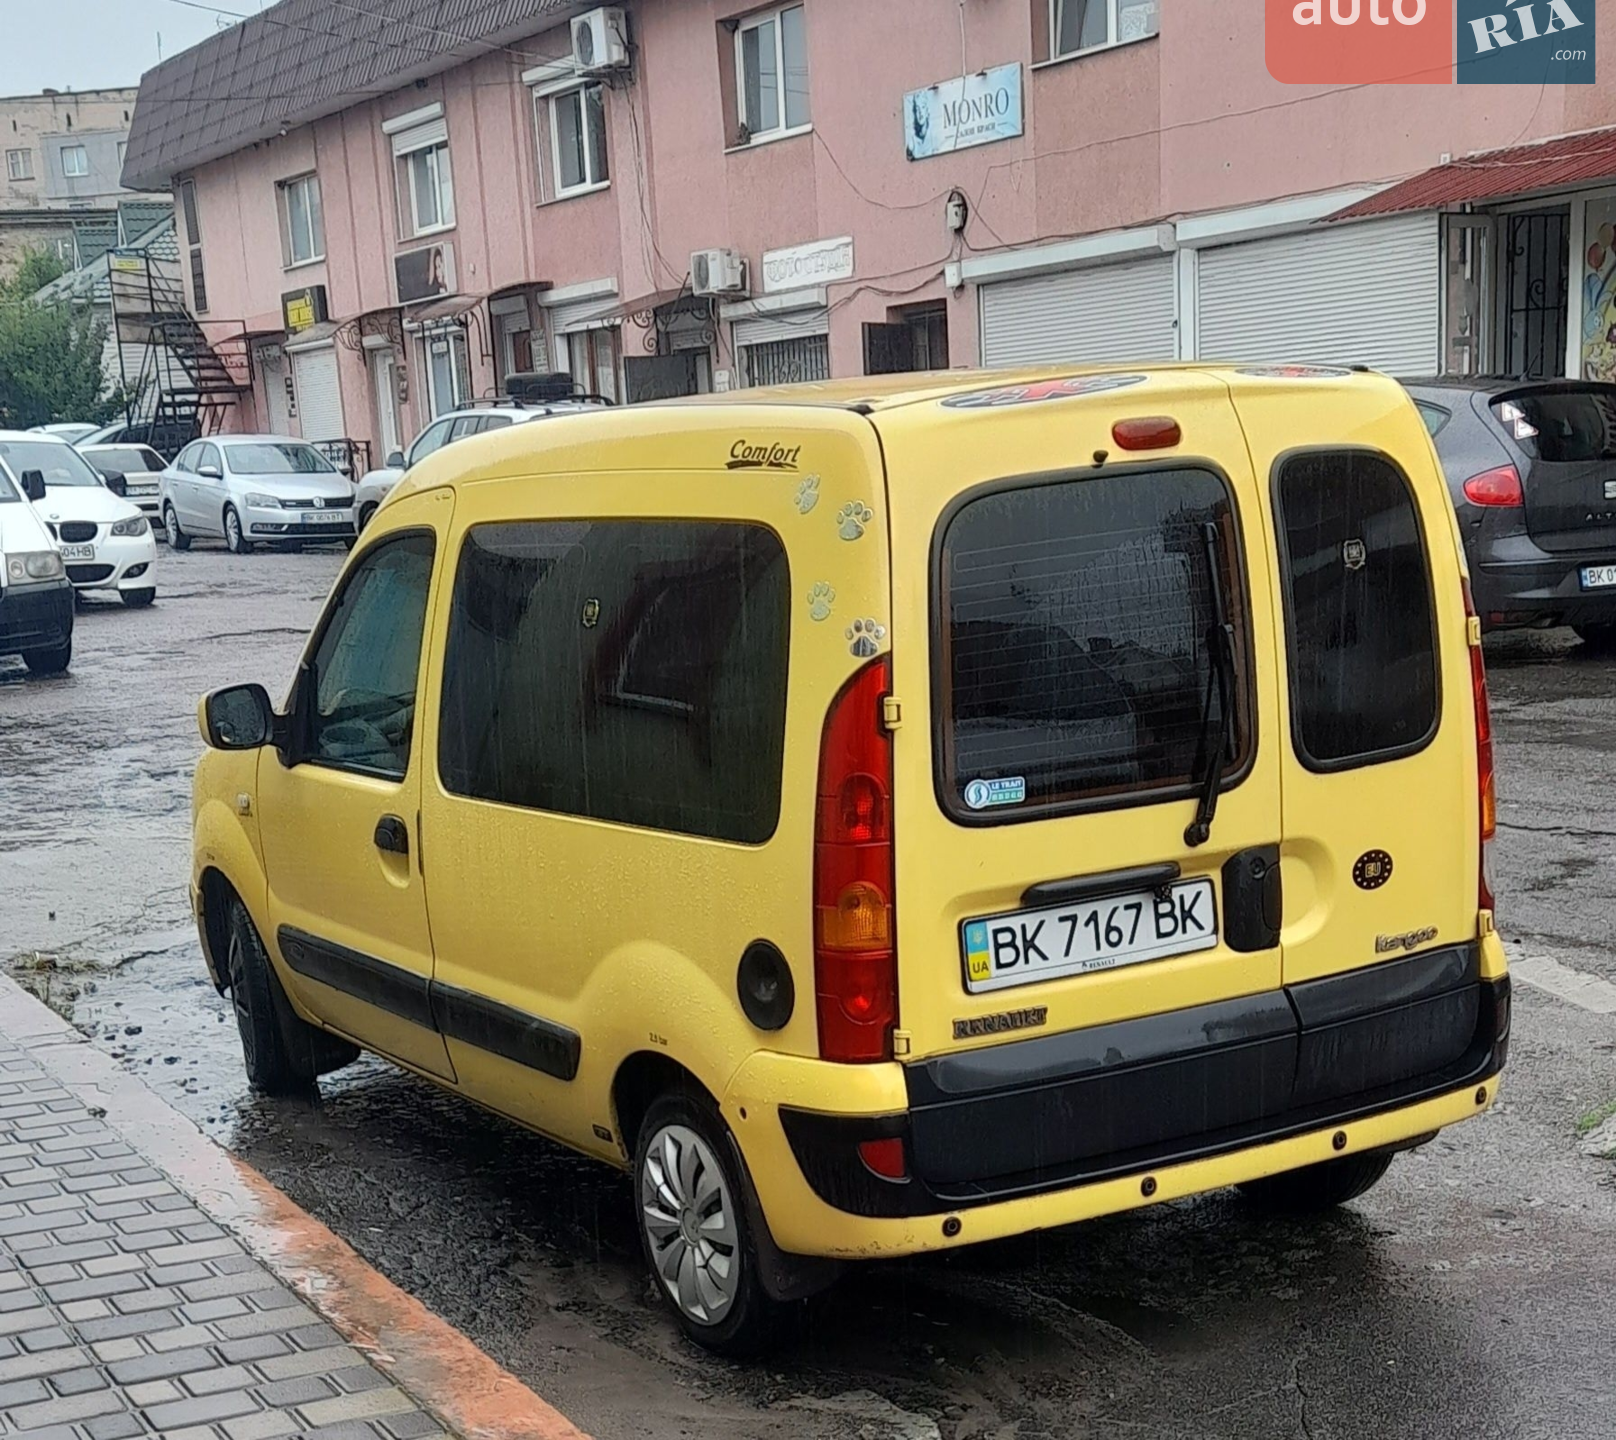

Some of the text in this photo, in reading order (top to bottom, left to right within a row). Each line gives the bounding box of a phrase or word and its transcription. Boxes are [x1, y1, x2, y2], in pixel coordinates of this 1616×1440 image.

[943, 87, 1009, 129] MONRO
[730, 439, 801, 463] Comfort
[1589, 569, 1605, 584] BK
[1365, 861, 1381, 878] EU
[992, 890, 1205, 970] BK 7167 BK
[972, 961, 990, 974] UA
